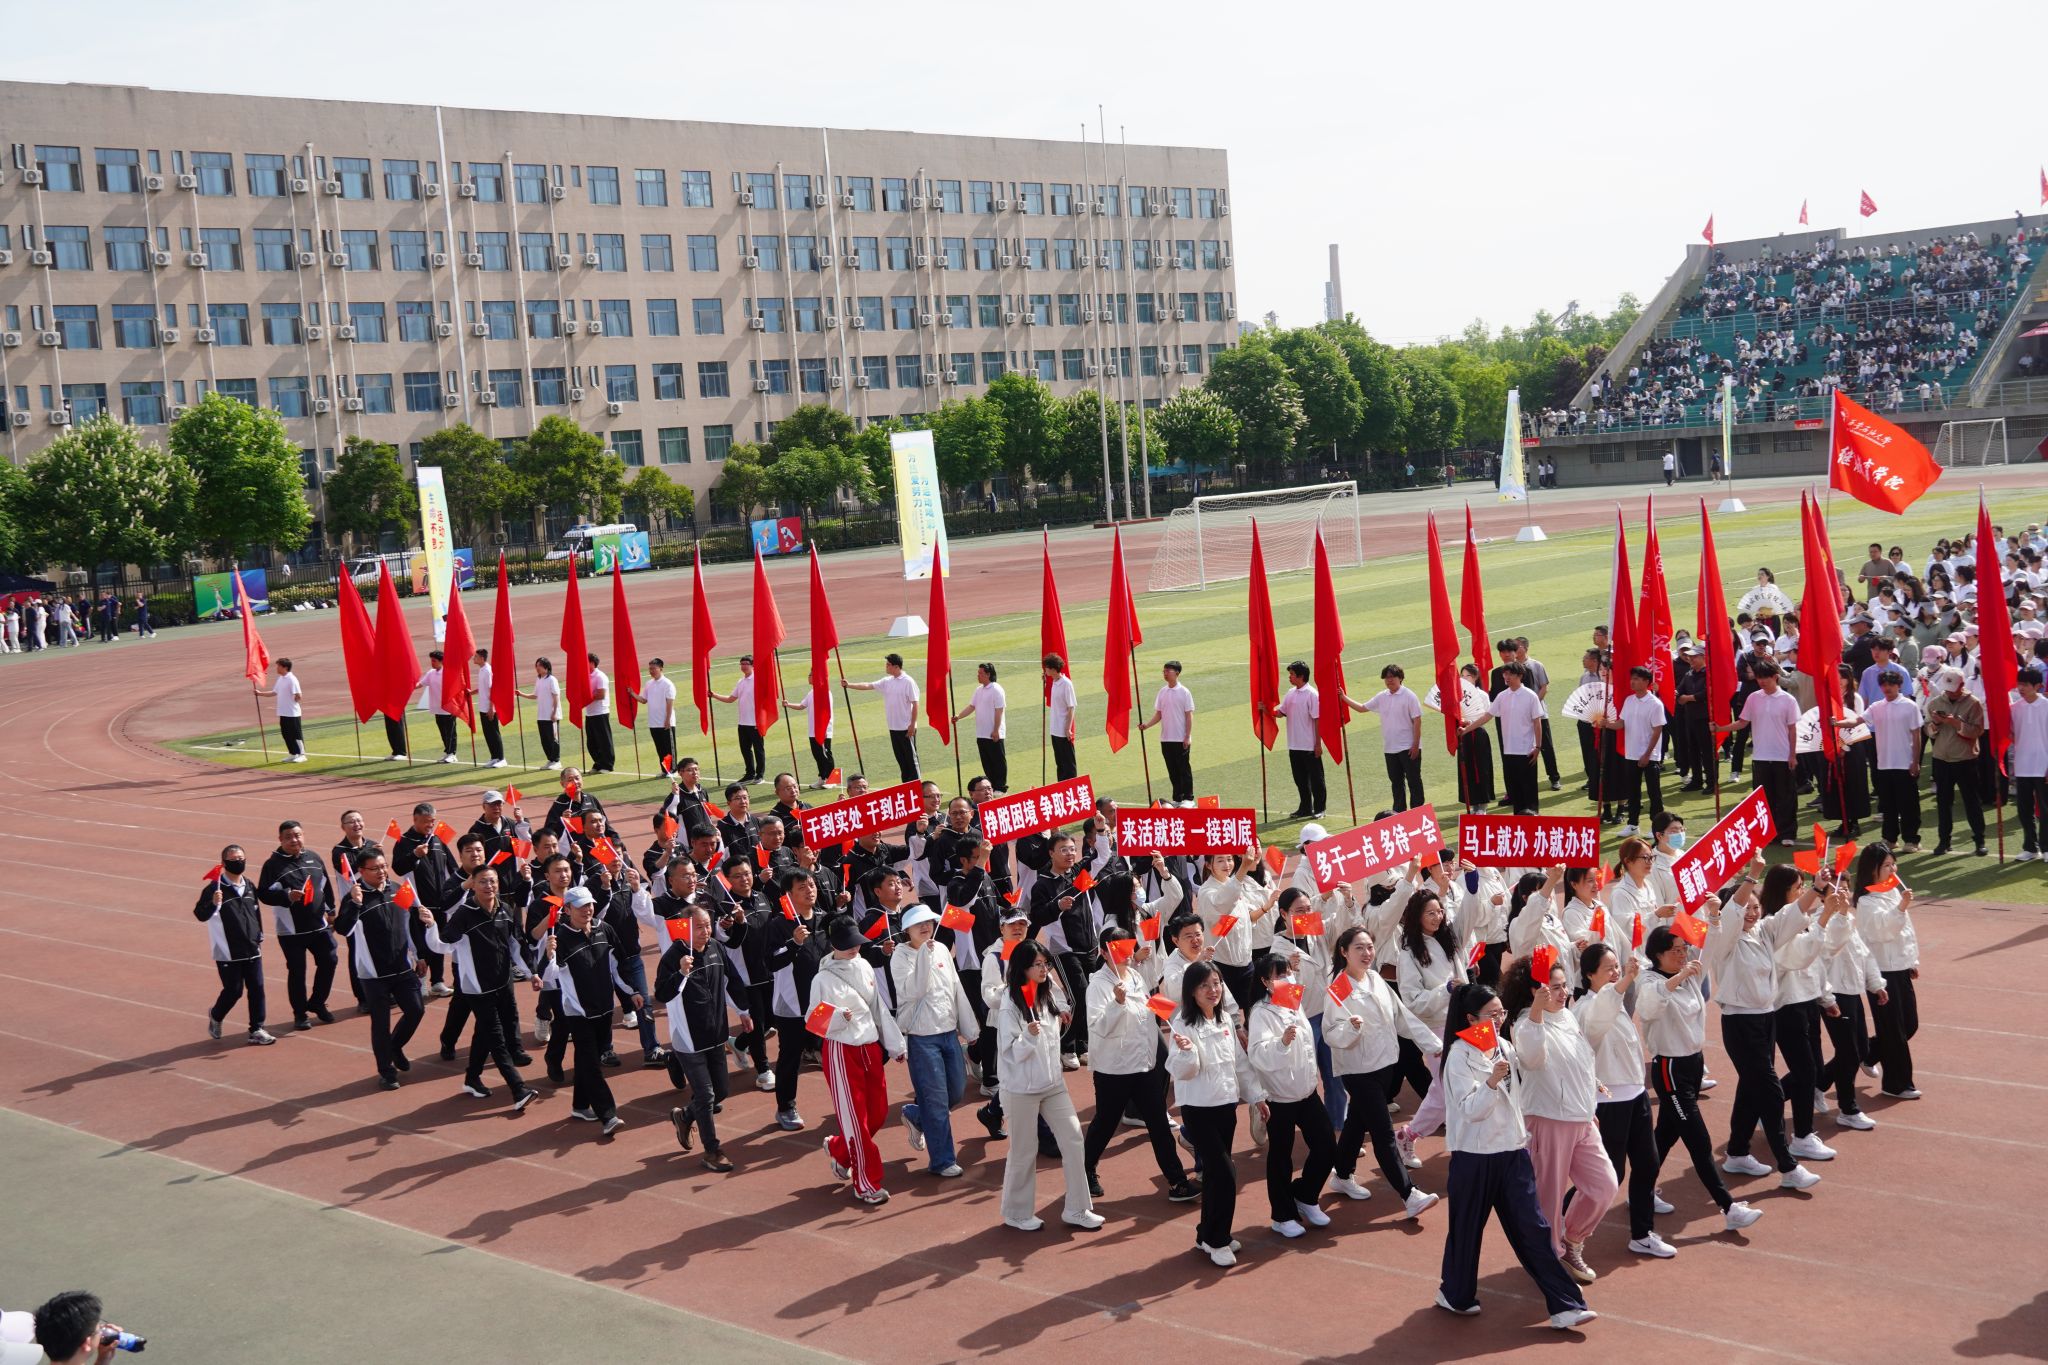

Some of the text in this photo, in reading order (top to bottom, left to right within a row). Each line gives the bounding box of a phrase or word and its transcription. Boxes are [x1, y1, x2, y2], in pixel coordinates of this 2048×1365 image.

[807, 790, 920, 842] 干到实处 干到点上
[984, 784, 1091, 838] 挣脱困境 争取头筹
[1122, 818, 1253, 848] 来活就接 一接到底
[1316, 815, 1437, 883] 多干一点 多待一会
[1464, 825, 1595, 859] 马上就办 办就办好
[1680, 801, 1768, 903] 靠前一步 往深一步
[1671, 1094, 1687, 1121] MOMENT
